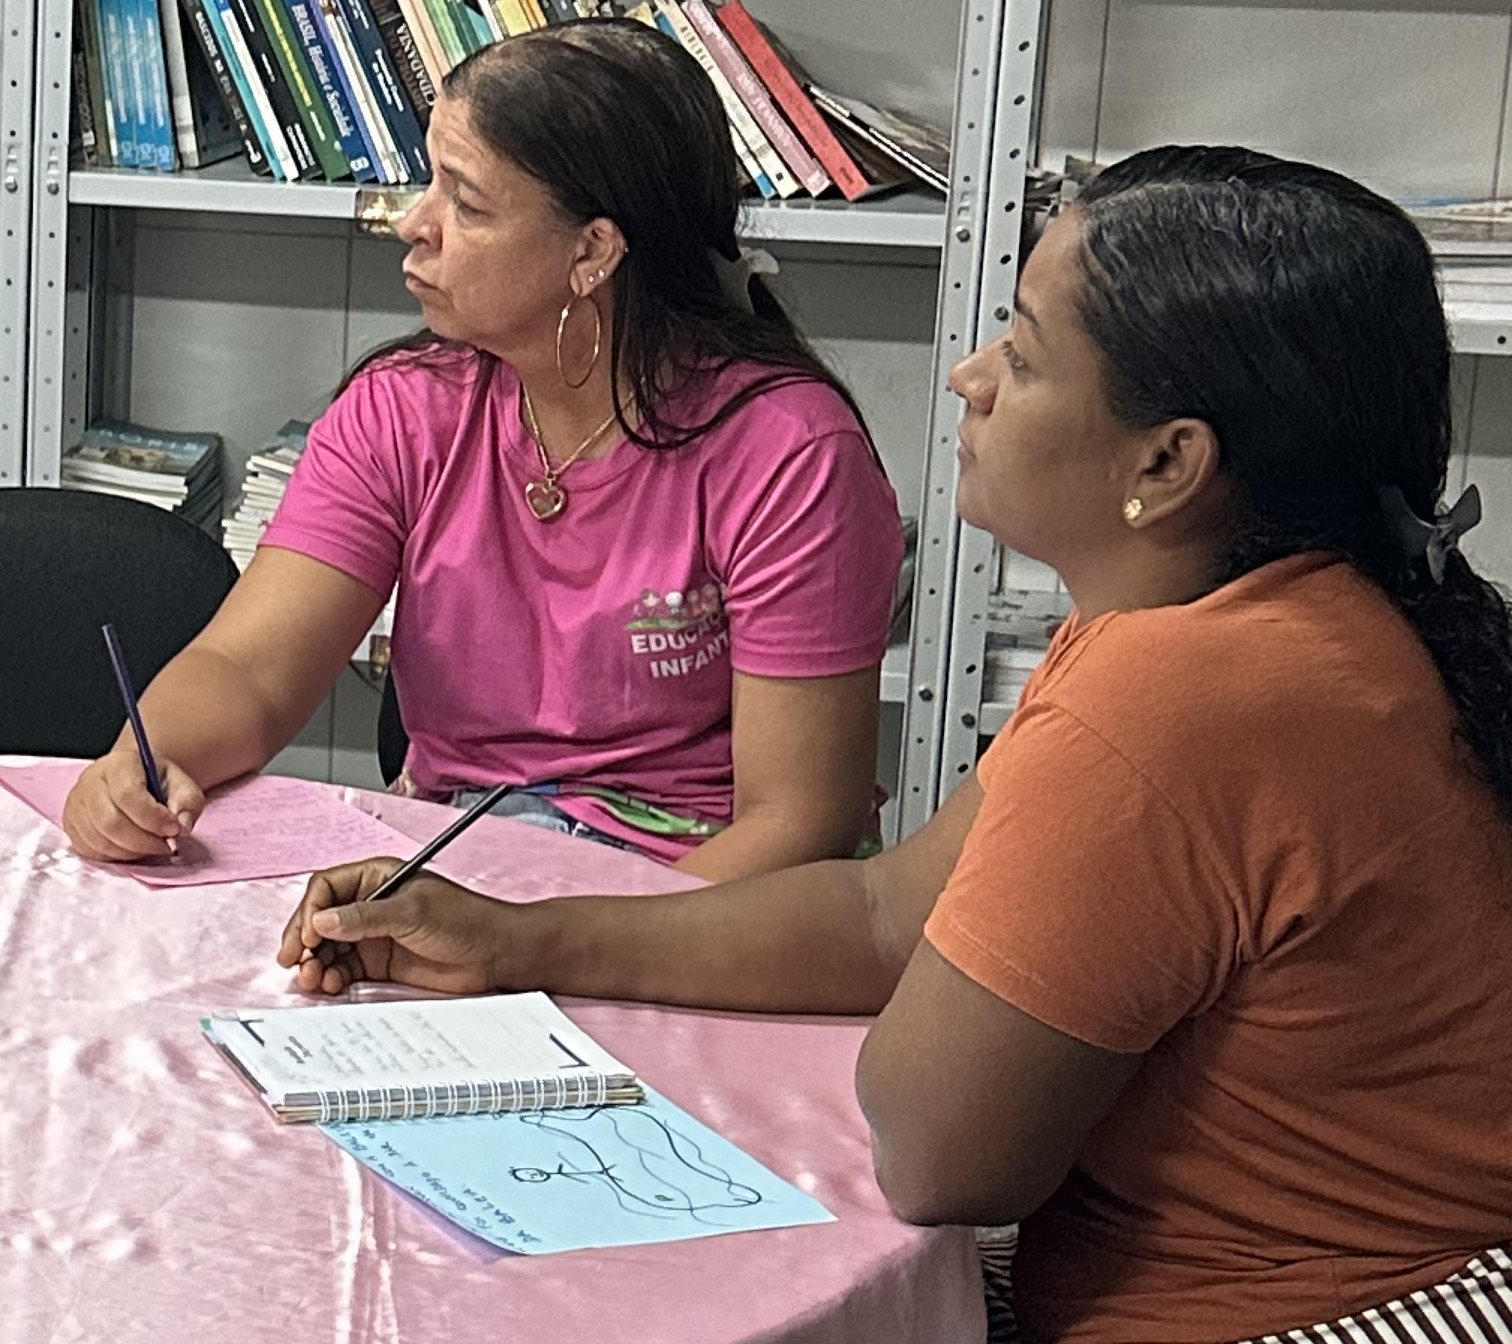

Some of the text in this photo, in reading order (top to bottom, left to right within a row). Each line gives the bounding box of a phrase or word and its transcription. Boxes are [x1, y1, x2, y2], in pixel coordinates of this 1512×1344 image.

[290, 2, 318, 45] BRASIL,
[631, 613, 723, 654] EDUCAÇ
[650, 630, 730, 678] INFANT
